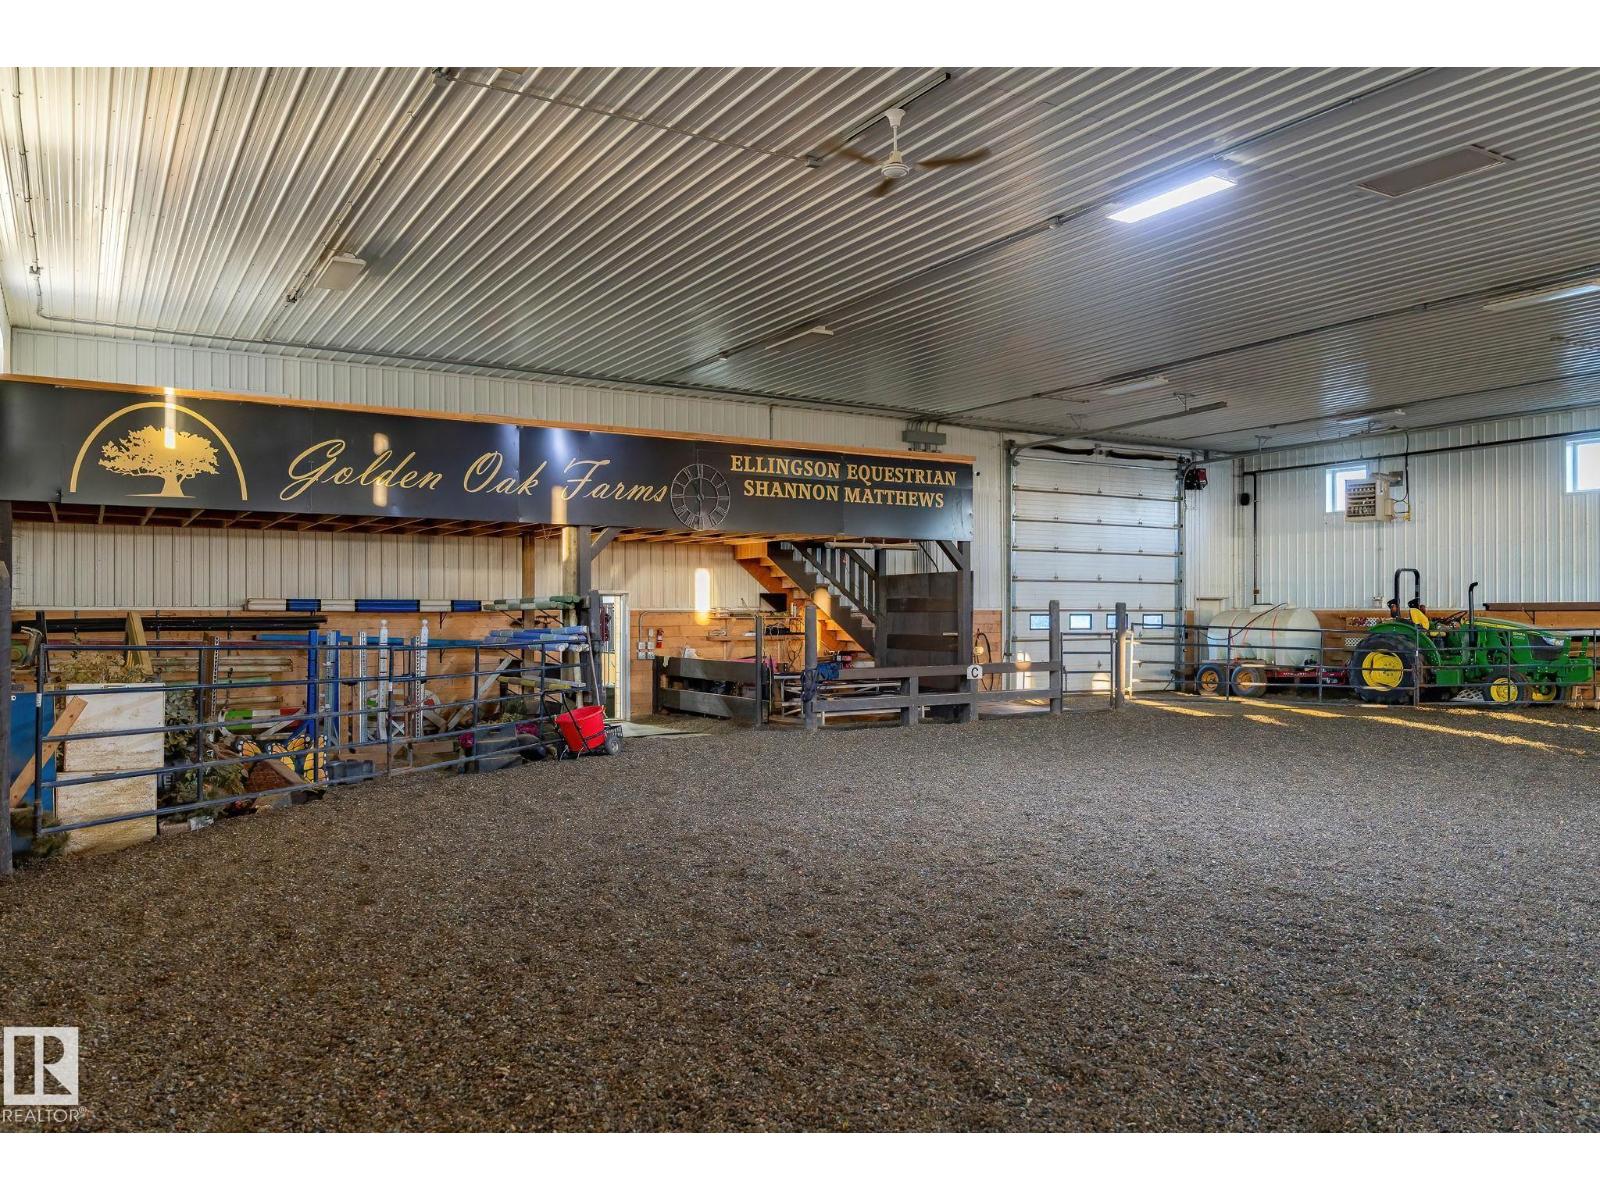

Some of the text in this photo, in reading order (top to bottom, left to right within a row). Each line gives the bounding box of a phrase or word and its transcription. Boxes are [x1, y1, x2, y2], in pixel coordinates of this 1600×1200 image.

[279, 439, 443, 501] Golden
[463, 450, 547, 496] Oak
[560, 457, 668, 502] Farms
[730, 454, 956, 487] ELLINGSON EQUESTRIAN
[743, 479, 944, 509] SHANNON MATTHEWS
[971, 666, 979, 679] C
